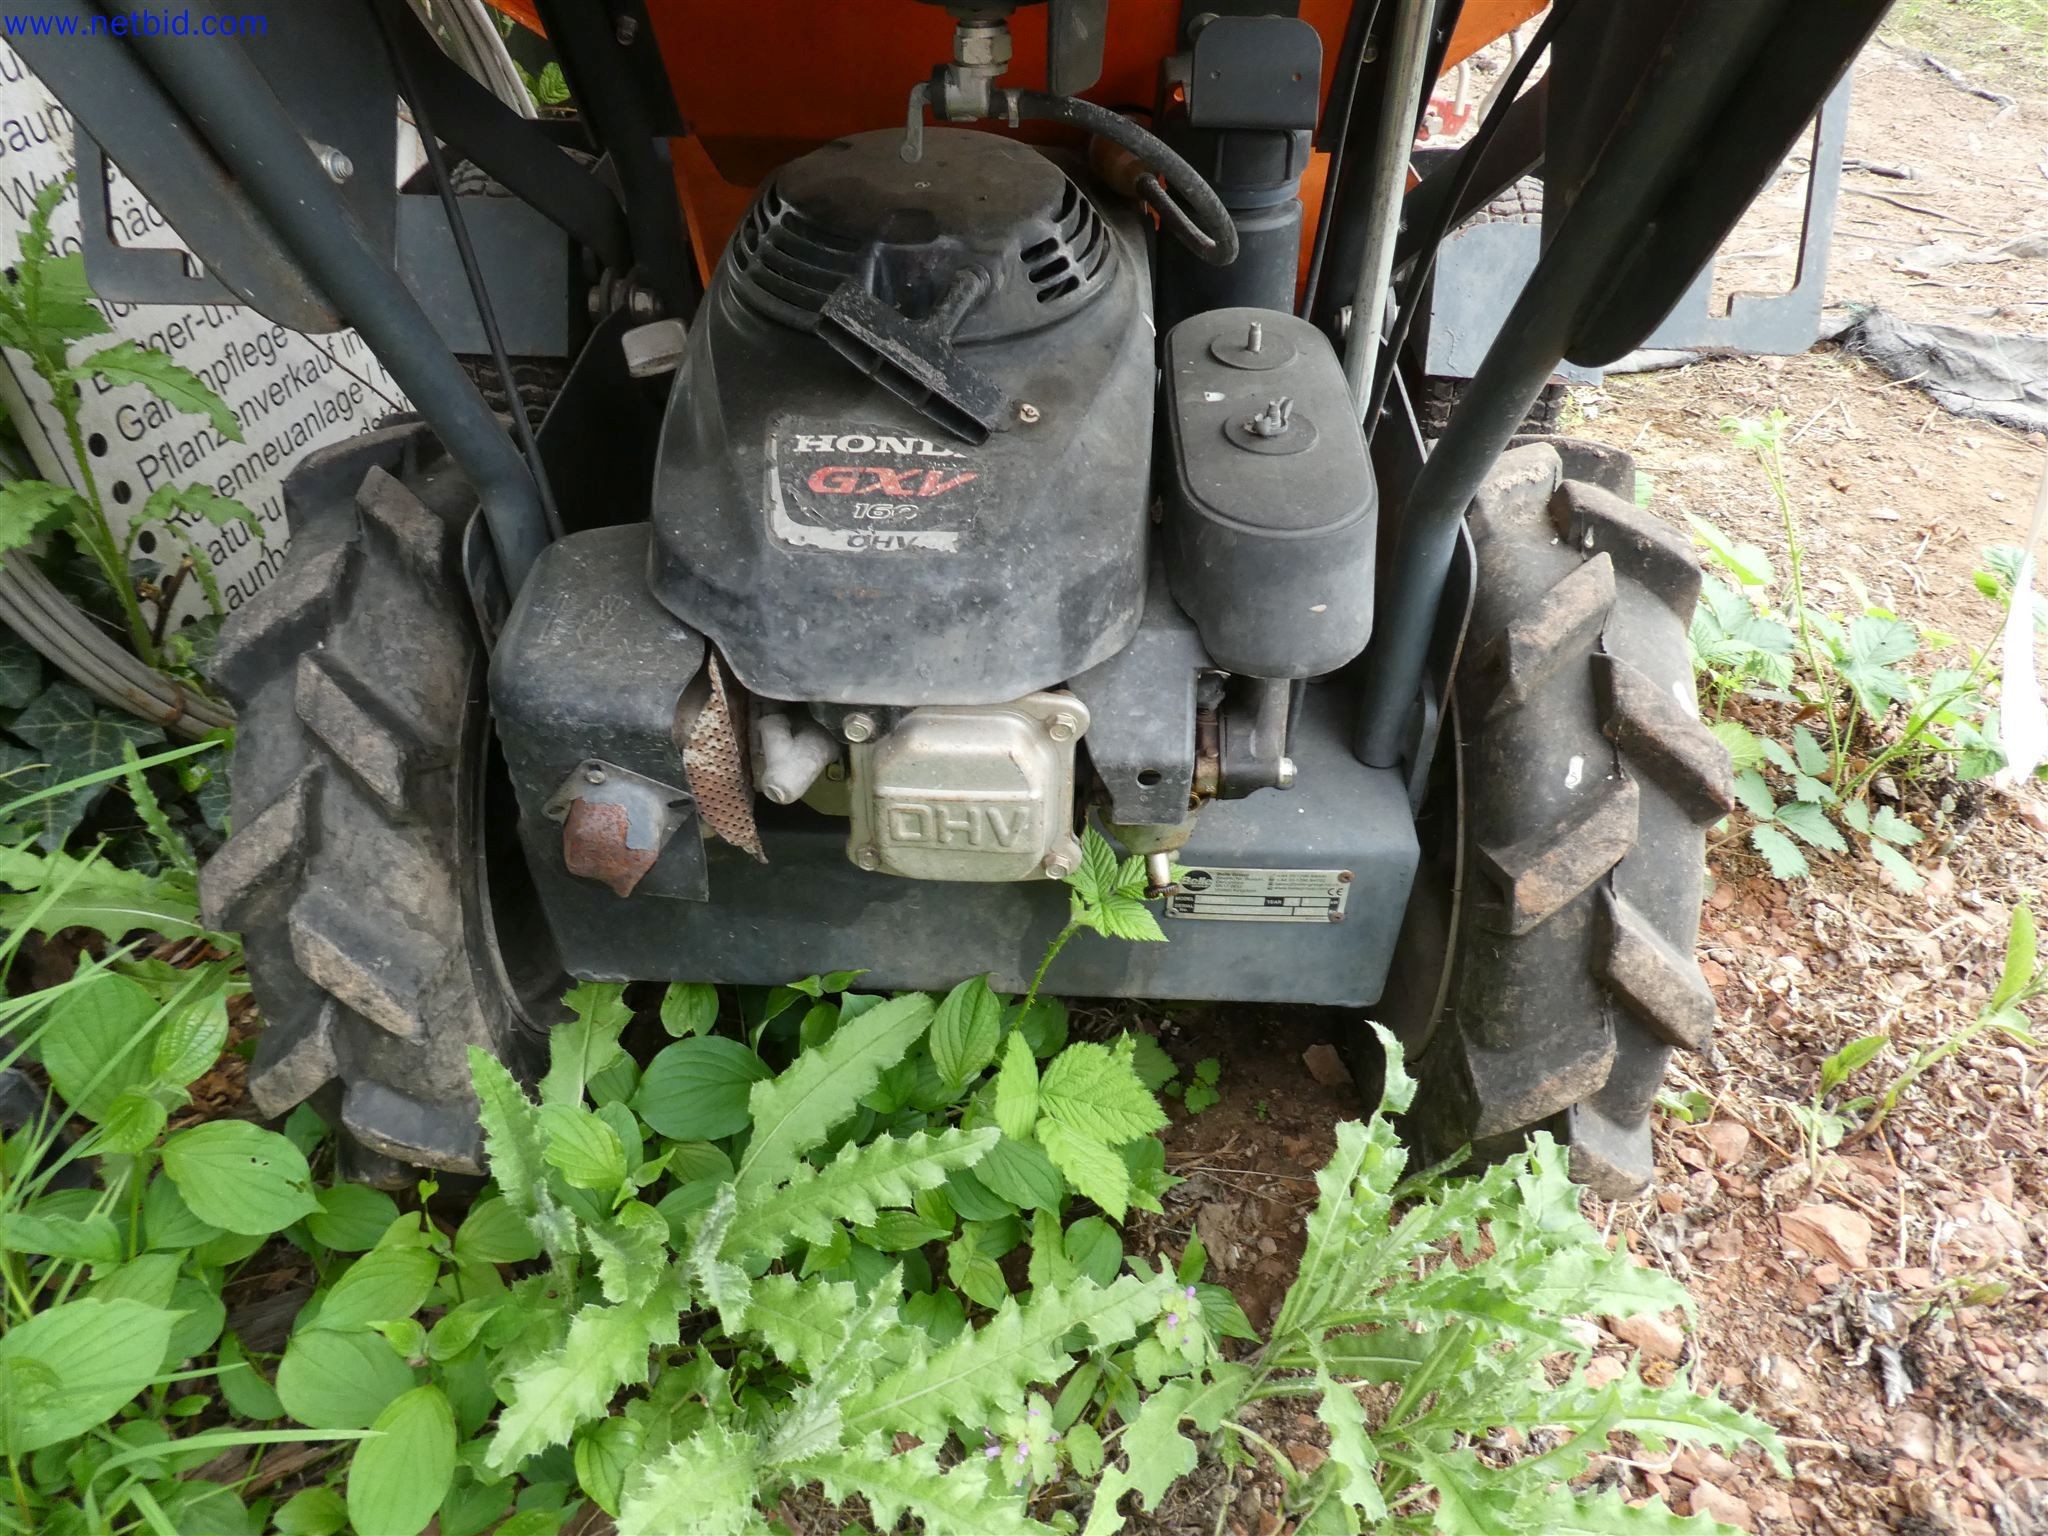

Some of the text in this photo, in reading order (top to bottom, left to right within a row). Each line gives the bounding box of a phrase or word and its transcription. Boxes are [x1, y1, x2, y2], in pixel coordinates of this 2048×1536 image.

[807, 465, 978, 496] GXV
[847, 534, 919, 549] OHV
[887, 802, 1030, 848] OHV
